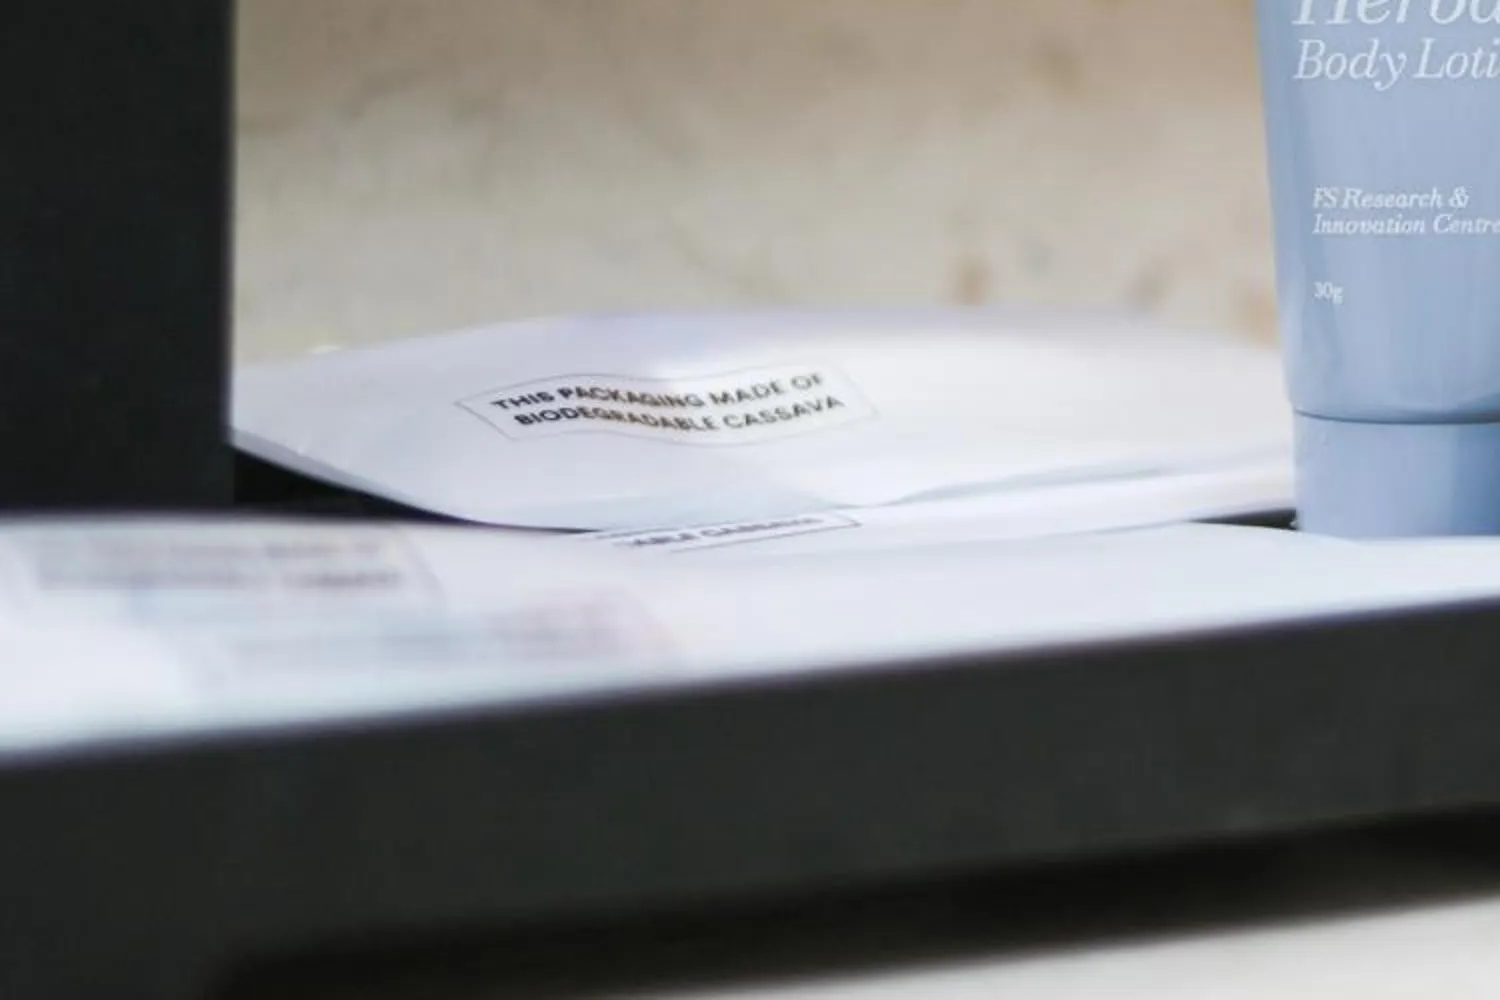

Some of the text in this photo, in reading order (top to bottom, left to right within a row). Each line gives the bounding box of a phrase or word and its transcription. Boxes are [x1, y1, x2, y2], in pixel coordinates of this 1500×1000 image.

[1293, 37, 1406, 91] Body
[1311, 186, 1471, 209] FS Research &
[1311, 213, 1426, 235] Innovation
[1313, 281, 1344, 305] 30g
[490, 372, 824, 410] THIS PACKAGING MADE OF
[513, 394, 846, 432] BIODEGRADABLE CASSAVA
